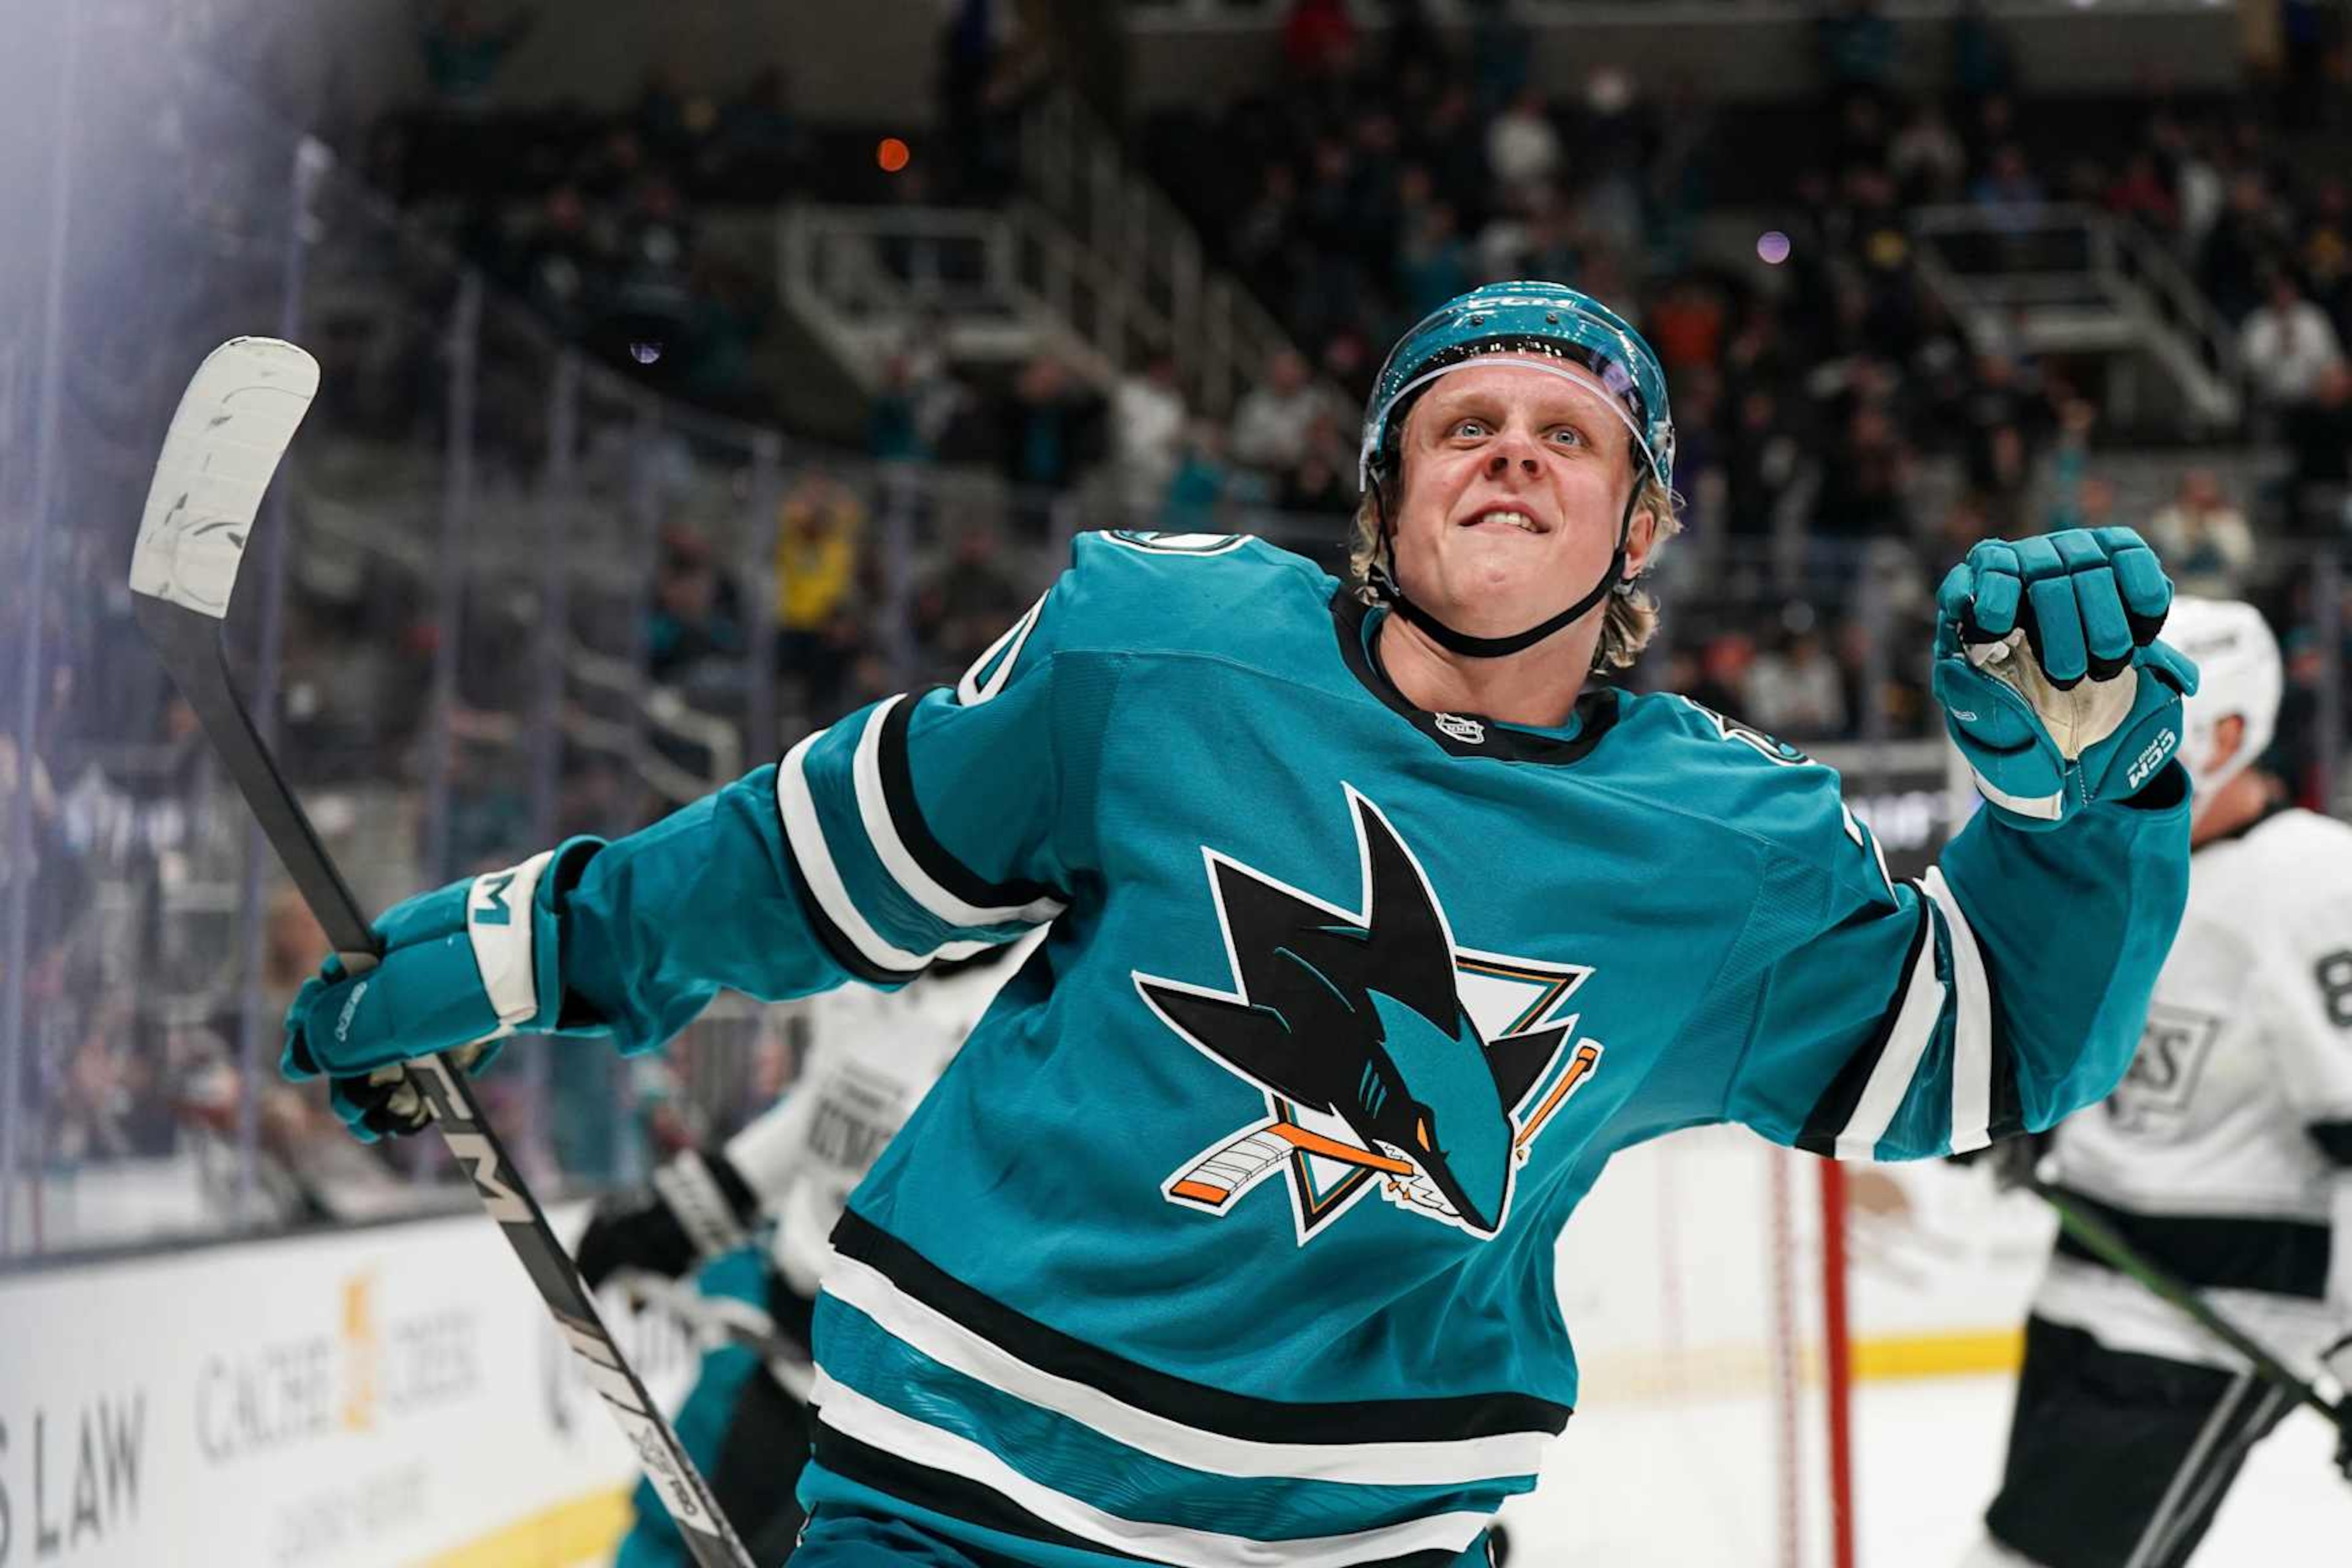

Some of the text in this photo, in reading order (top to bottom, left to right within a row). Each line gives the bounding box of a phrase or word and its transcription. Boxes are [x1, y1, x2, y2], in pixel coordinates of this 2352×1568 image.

[2128, 731, 2176, 790] CCM
[402, 1052, 535, 1224] CM
[34, 1384, 147, 1559] LAW
